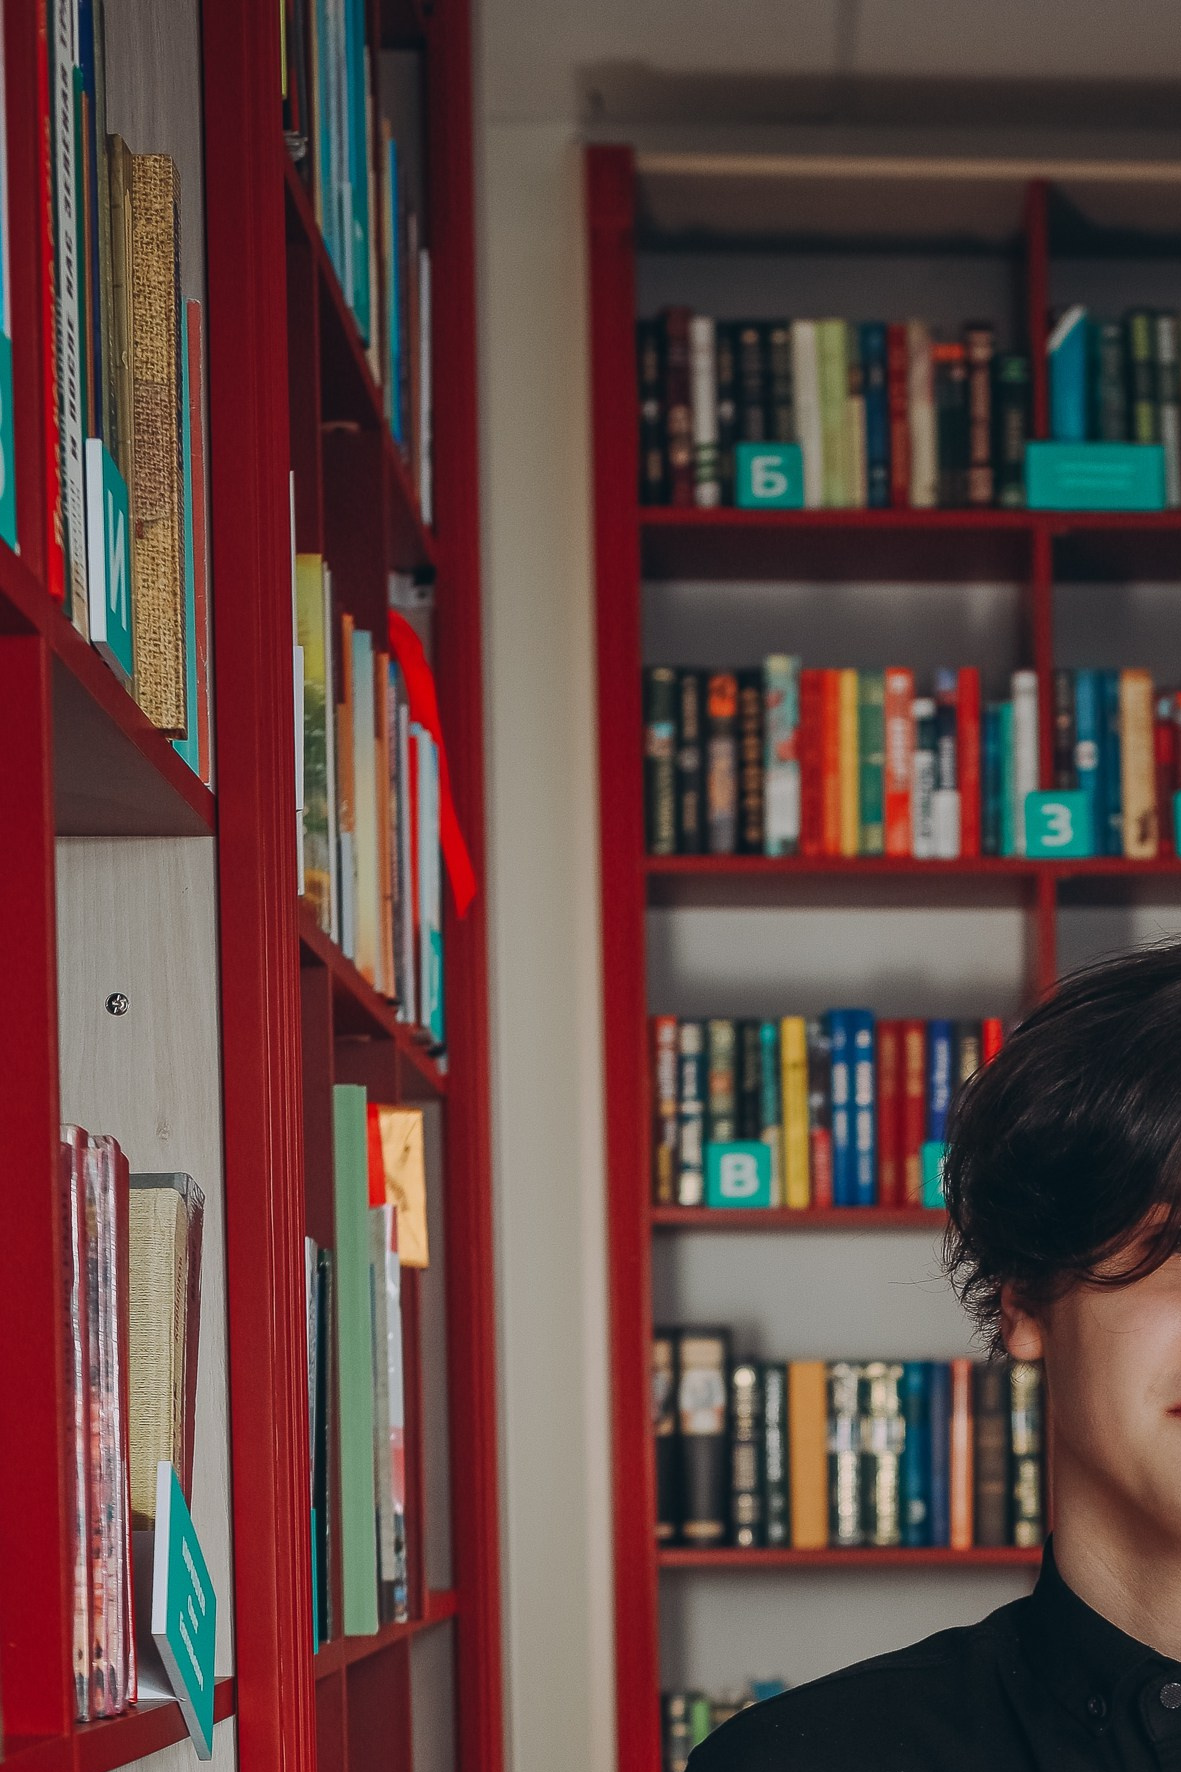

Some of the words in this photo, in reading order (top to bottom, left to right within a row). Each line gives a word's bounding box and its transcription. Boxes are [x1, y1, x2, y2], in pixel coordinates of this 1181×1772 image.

[64, 230, 75, 301] НАС
[750, 454, 788, 500] Б
[107, 488, 127, 632] И
[718, 1152, 759, 1199] В
